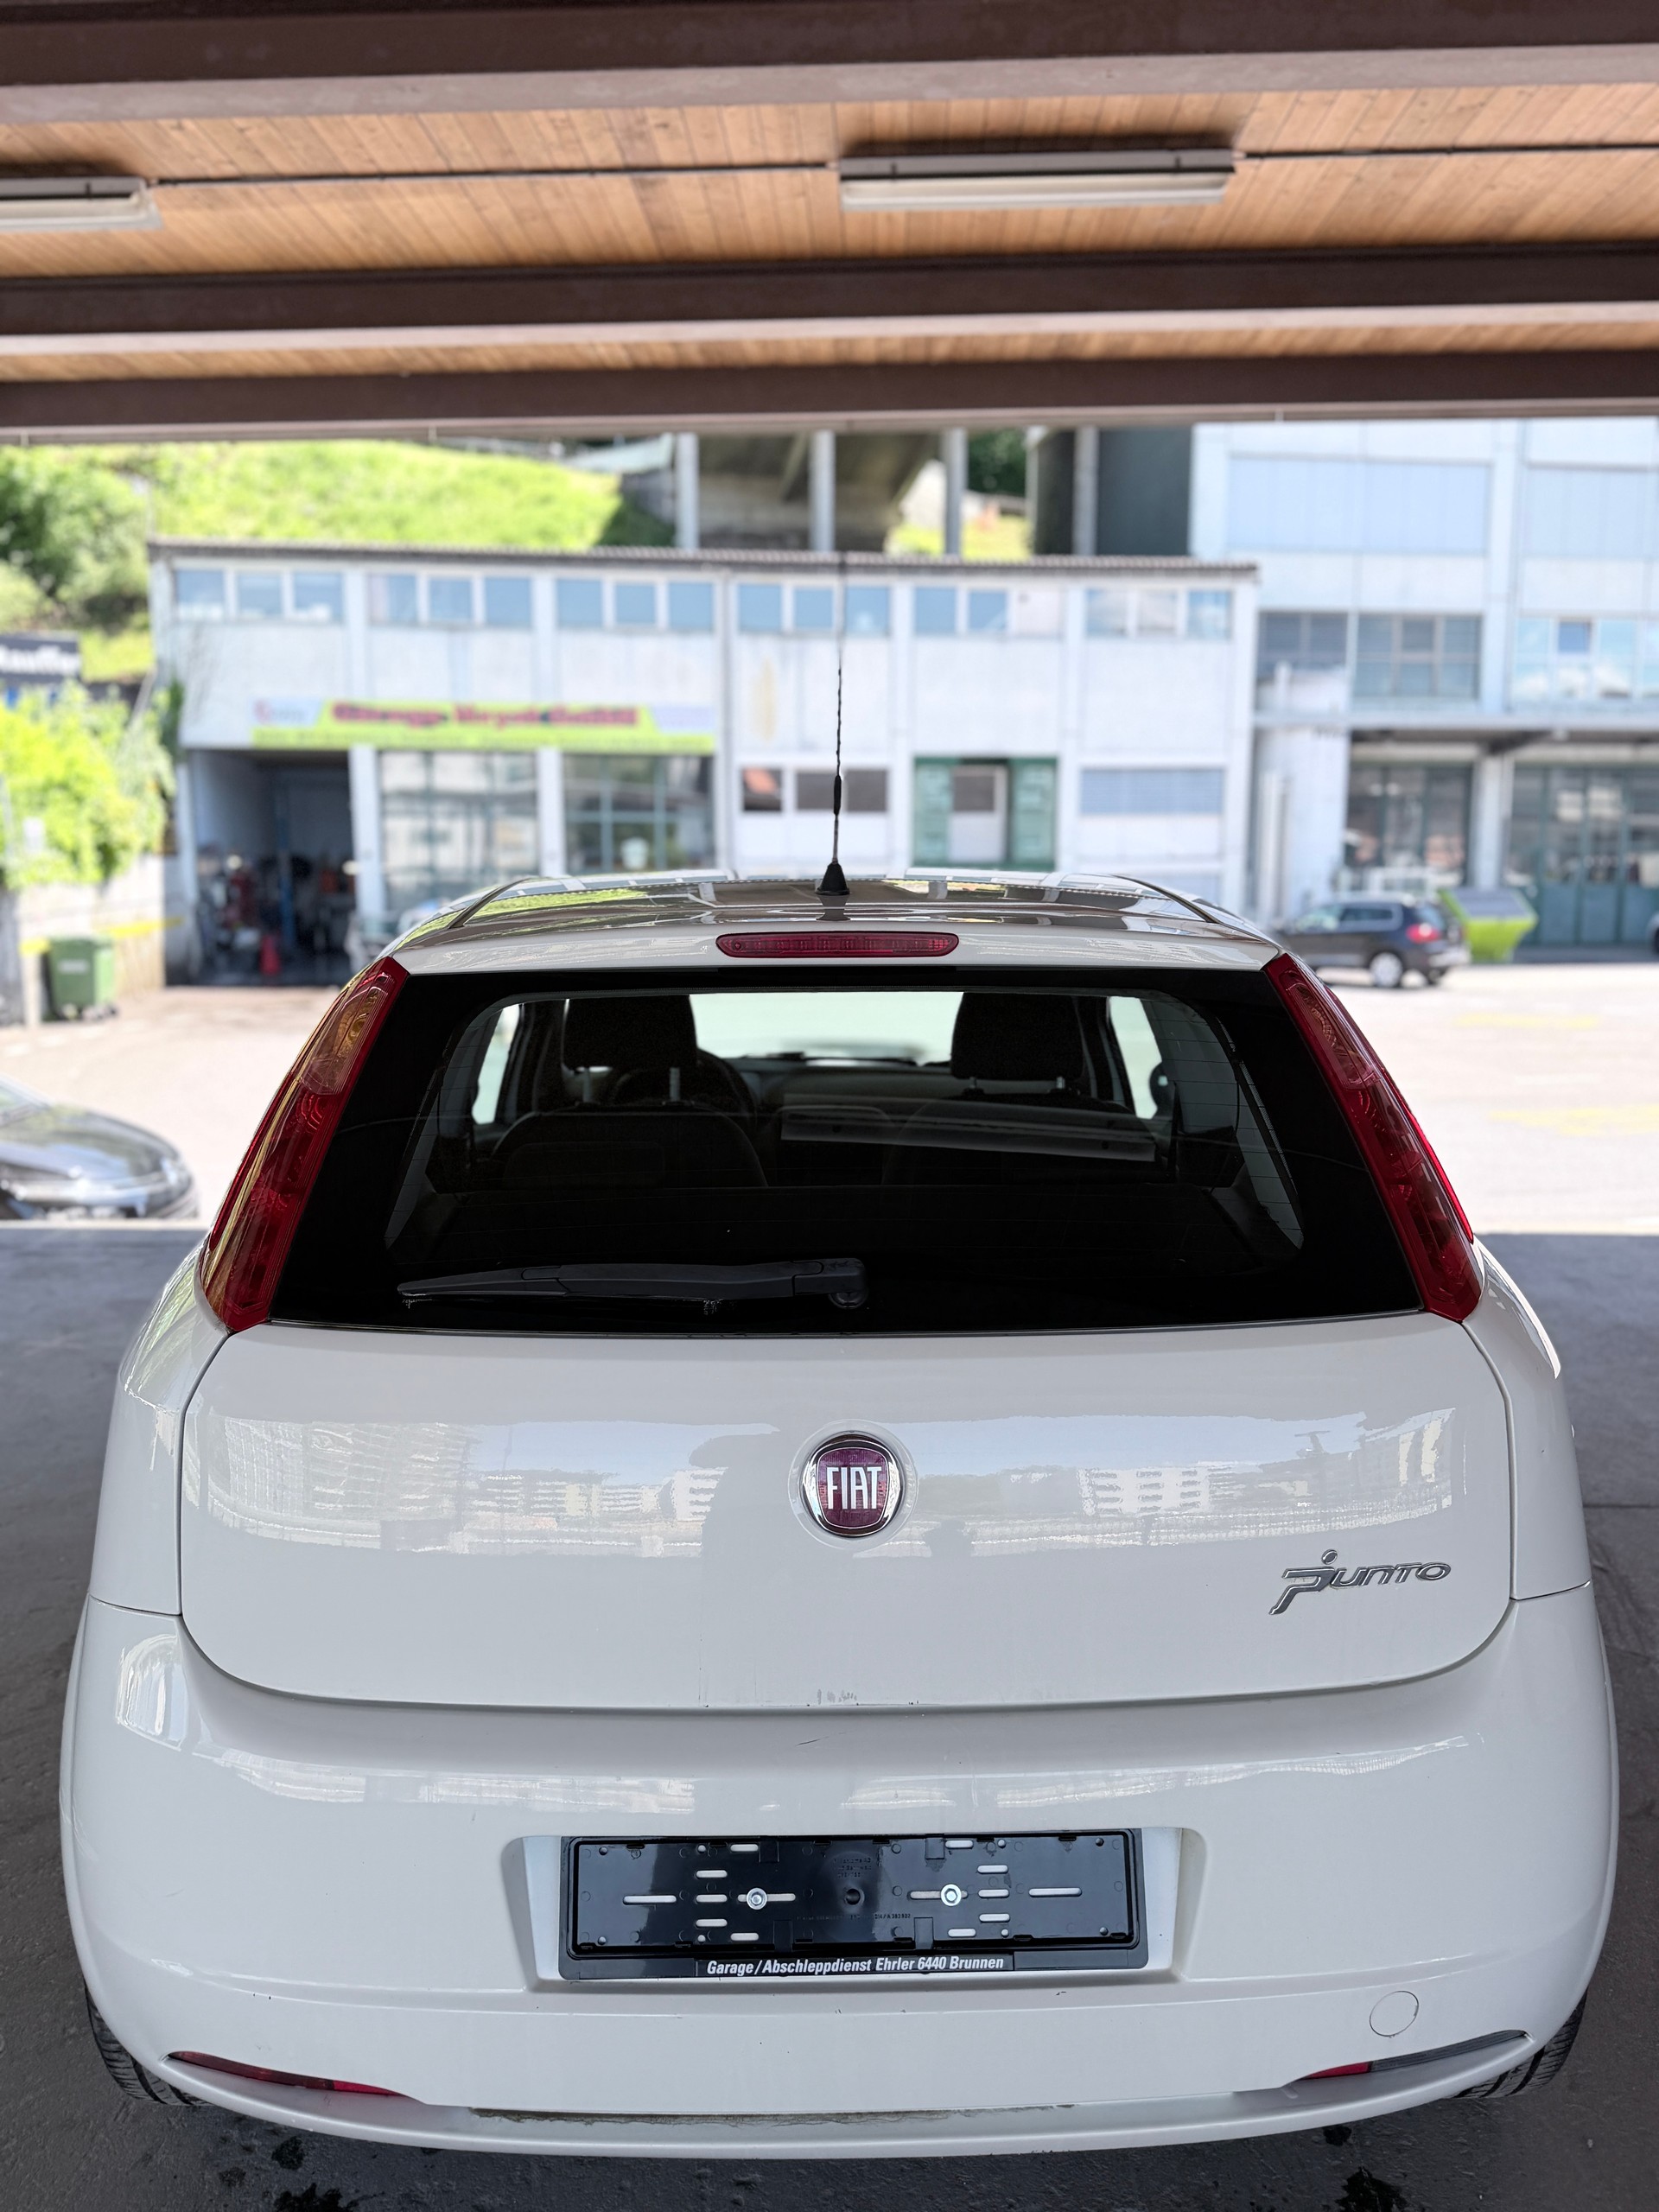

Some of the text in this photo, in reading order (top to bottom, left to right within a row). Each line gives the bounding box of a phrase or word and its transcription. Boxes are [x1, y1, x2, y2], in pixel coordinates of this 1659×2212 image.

[826, 1466, 882, 1510] FIAT
[875, 1957, 915, 1971] Ehrler
[917, 1956, 946, 1970] 6440
[949, 1955, 1004, 1969] Brunnen
